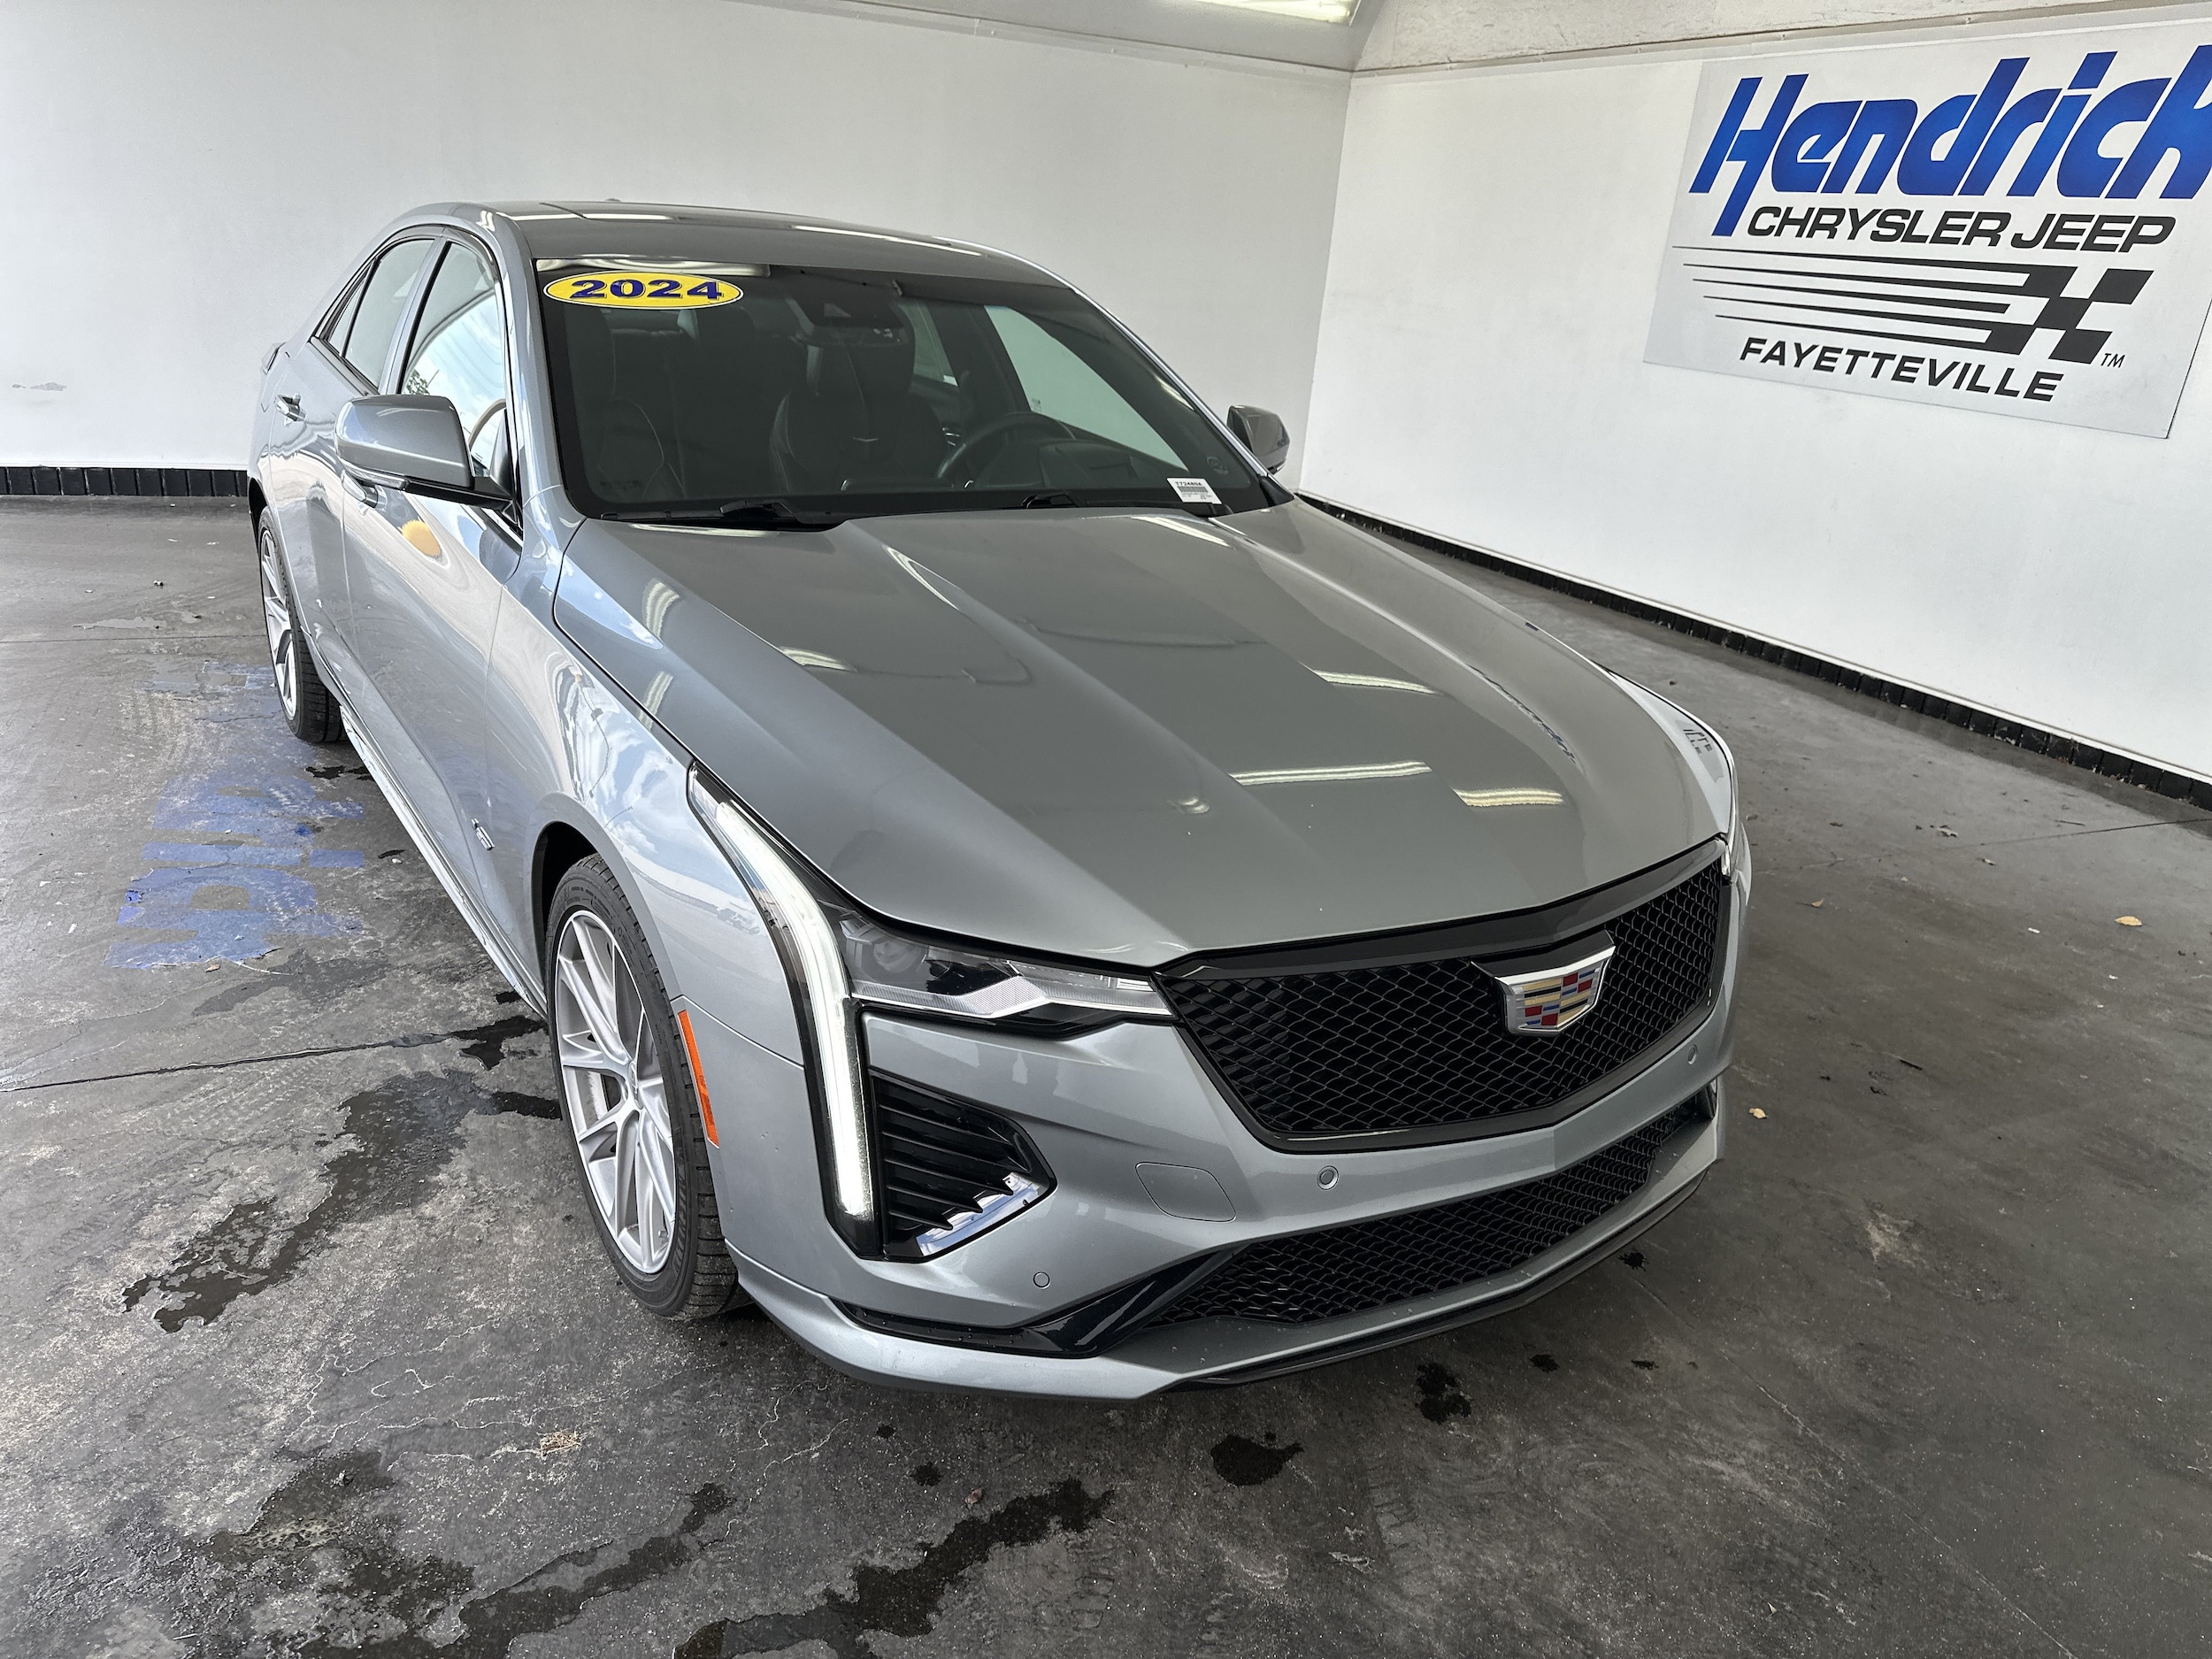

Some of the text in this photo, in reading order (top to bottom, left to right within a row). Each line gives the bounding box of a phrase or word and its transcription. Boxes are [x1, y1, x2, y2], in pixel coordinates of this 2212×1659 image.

[1689, 44, 2212, 237] Hendrick
[1747, 205, 2177, 253] CHRYSLER JEEP
[569, 279, 725, 300] 2024
[1740, 337, 2064, 402] FAYETTEVILLE
[2101, 352, 2125, 368] TM
